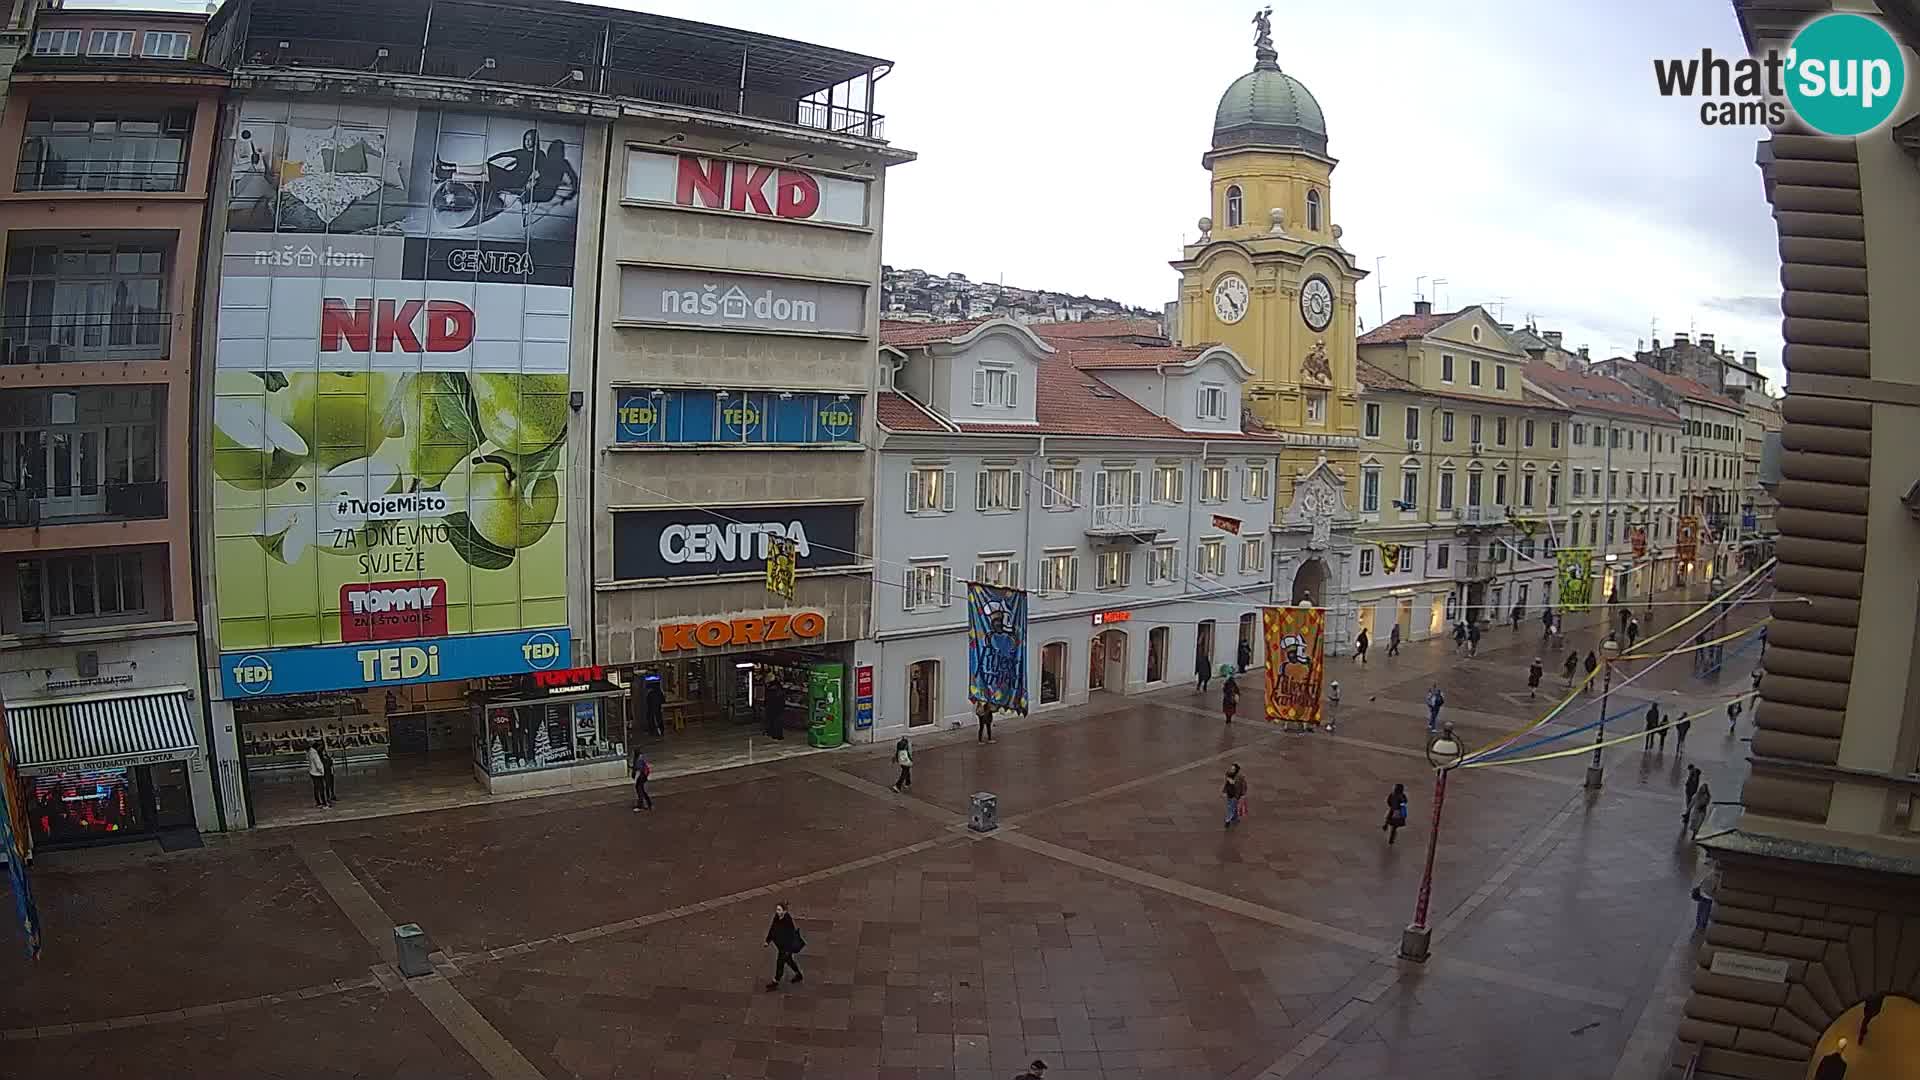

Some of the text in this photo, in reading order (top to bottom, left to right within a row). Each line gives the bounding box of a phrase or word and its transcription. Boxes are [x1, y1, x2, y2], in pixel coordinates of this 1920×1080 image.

[676, 156, 821, 219] NKD
[254, 246, 365, 267] naš dom
[447, 249, 534, 275] CENTRA
[661, 284, 816, 322] naš dom
[320, 297, 476, 353] NKD
[619, 407, 657, 424] TEDi
[723, 409, 759, 425] TEDi
[820, 411, 853, 426] TEDi
[338, 497, 446, 516] #TvojeMisto
[333, 523, 450, 549] ZA DNEVNO
[359, 547, 425, 575] SVJEŽE
[349, 586, 438, 613] TOMMY
[659, 612, 826, 653] KORZO
[358, 645, 439, 682] TEDi
[521, 643, 560, 660] TEDi
[233, 665, 273, 684] TEDi
